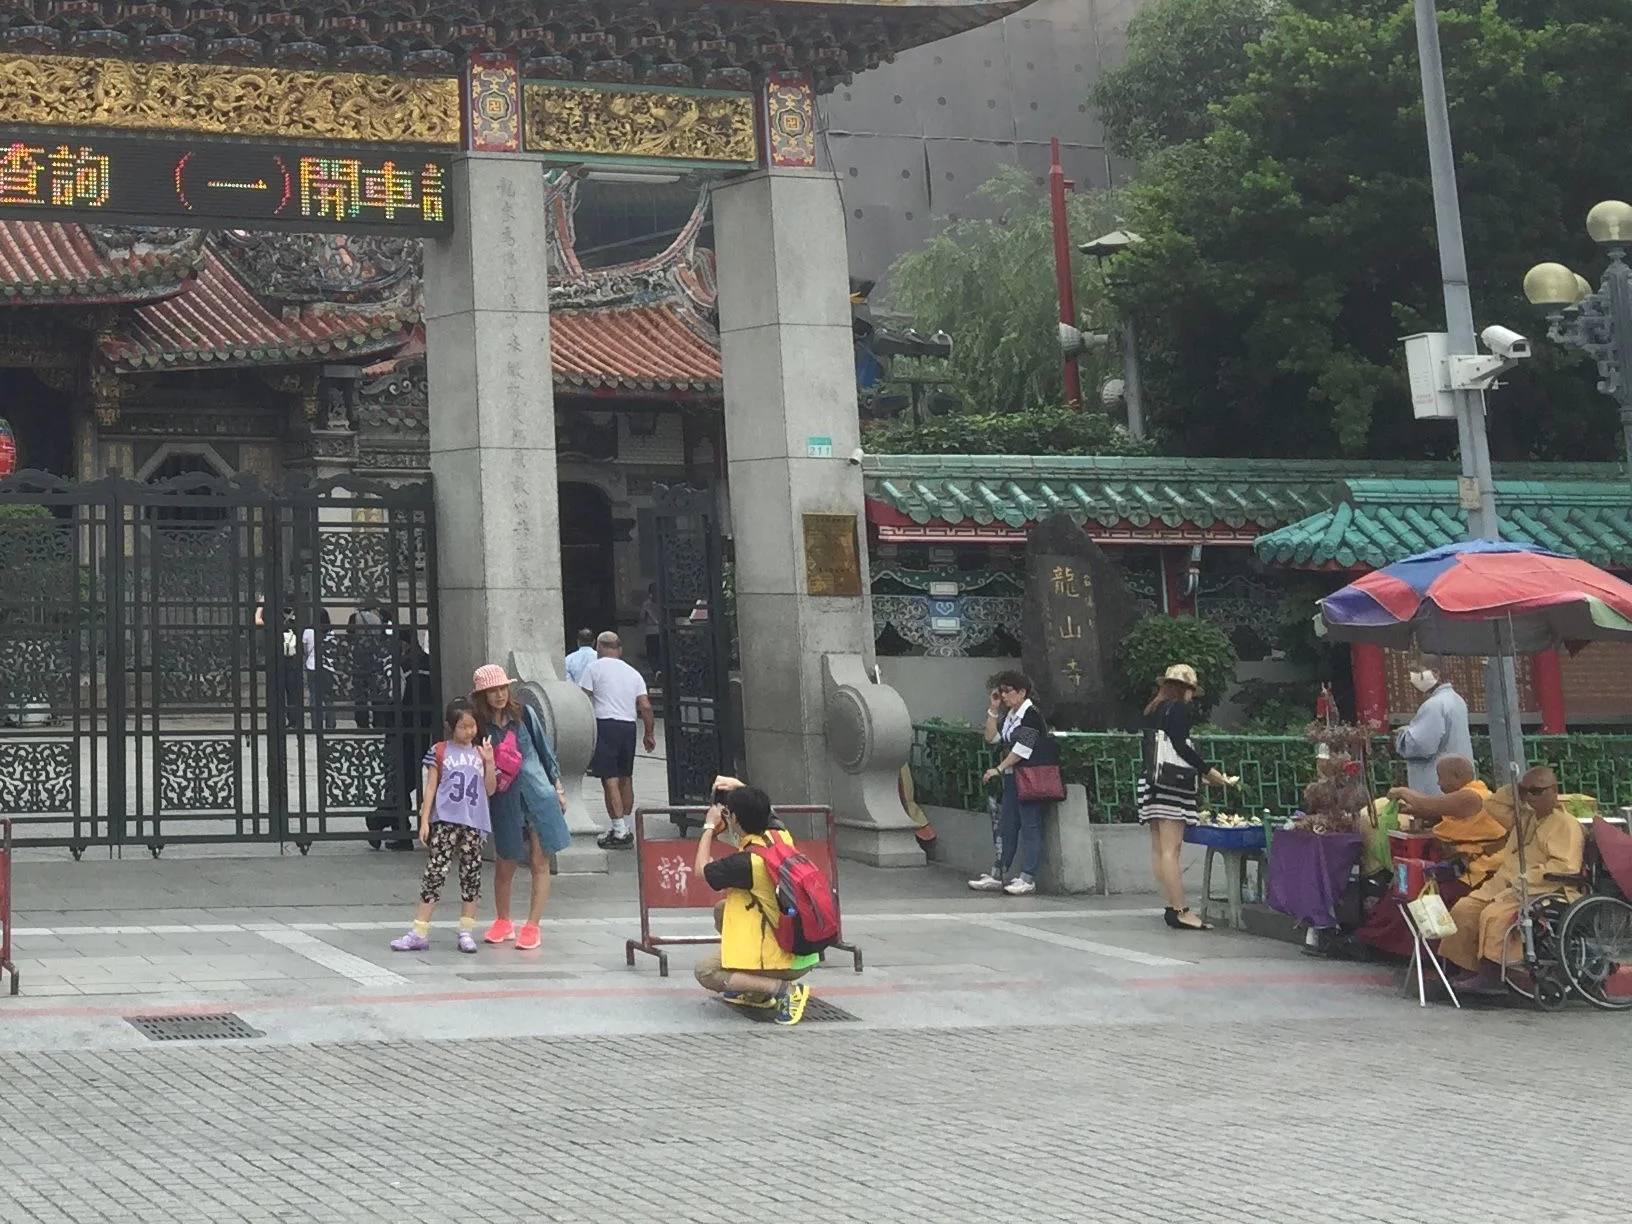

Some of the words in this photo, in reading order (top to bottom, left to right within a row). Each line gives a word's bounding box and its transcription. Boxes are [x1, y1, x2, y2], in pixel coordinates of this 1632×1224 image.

[809, 446, 830, 457] 211
[1050, 565, 1083, 687] 龍山寺
[449, 770, 479, 807] 34
